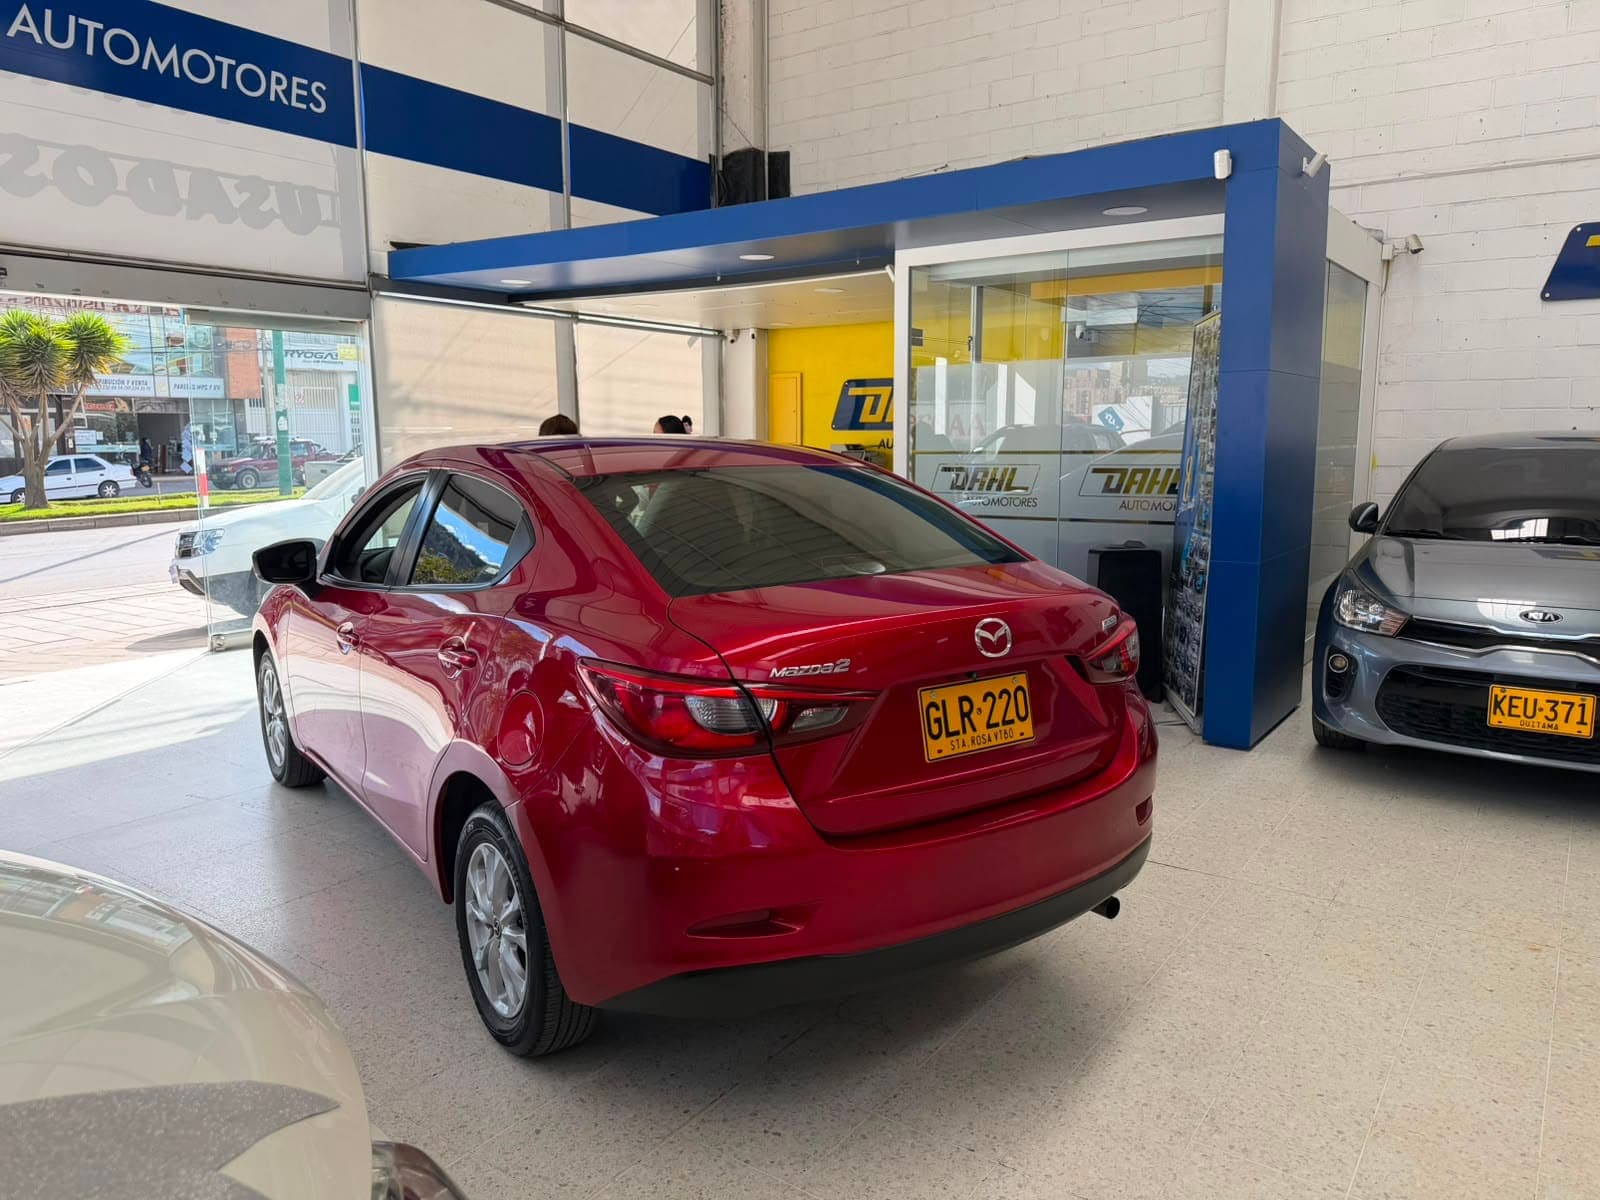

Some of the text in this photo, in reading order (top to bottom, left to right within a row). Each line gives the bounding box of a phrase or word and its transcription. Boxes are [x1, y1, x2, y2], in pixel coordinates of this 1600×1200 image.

[6, 3, 327, 113] AUTOMOTORES
[941, 466, 1029, 491] DAHL
[967, 496, 1038, 508] AUTOMOTORES
[1528, 611, 1555, 621] KIA
